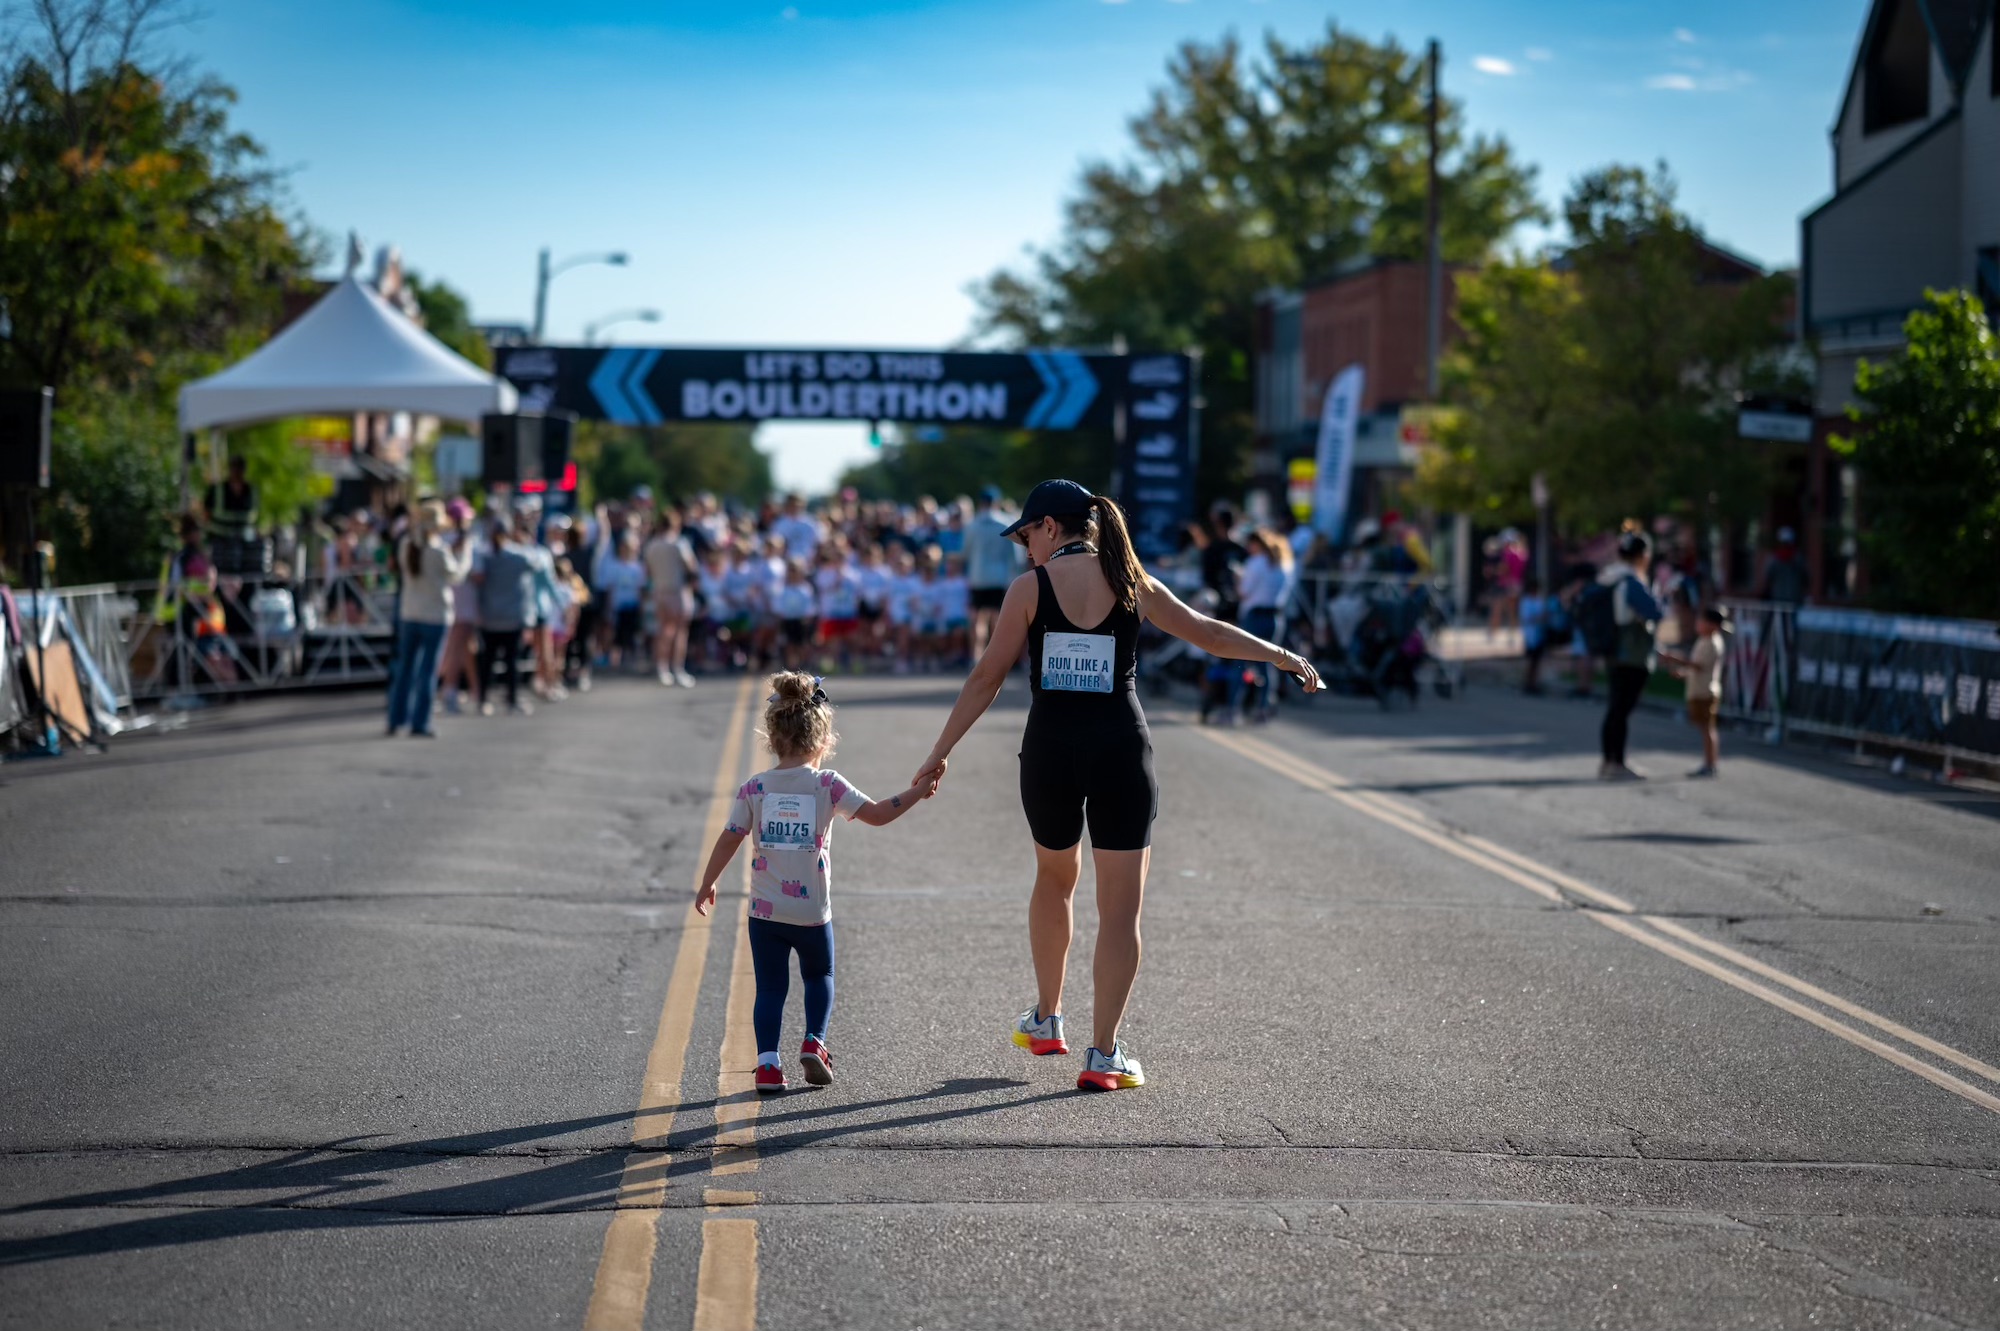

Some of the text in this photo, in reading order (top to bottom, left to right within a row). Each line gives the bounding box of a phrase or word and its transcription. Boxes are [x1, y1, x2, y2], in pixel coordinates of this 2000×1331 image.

[745, 353, 945, 381] LET'S DO THIS
[683, 379, 1007, 419] BOULDERTHON
[1048, 657, 1109, 673] RUN LIKE A
[1055, 673, 1100, 688] MOTHER
[768, 821, 809, 837] 60175
